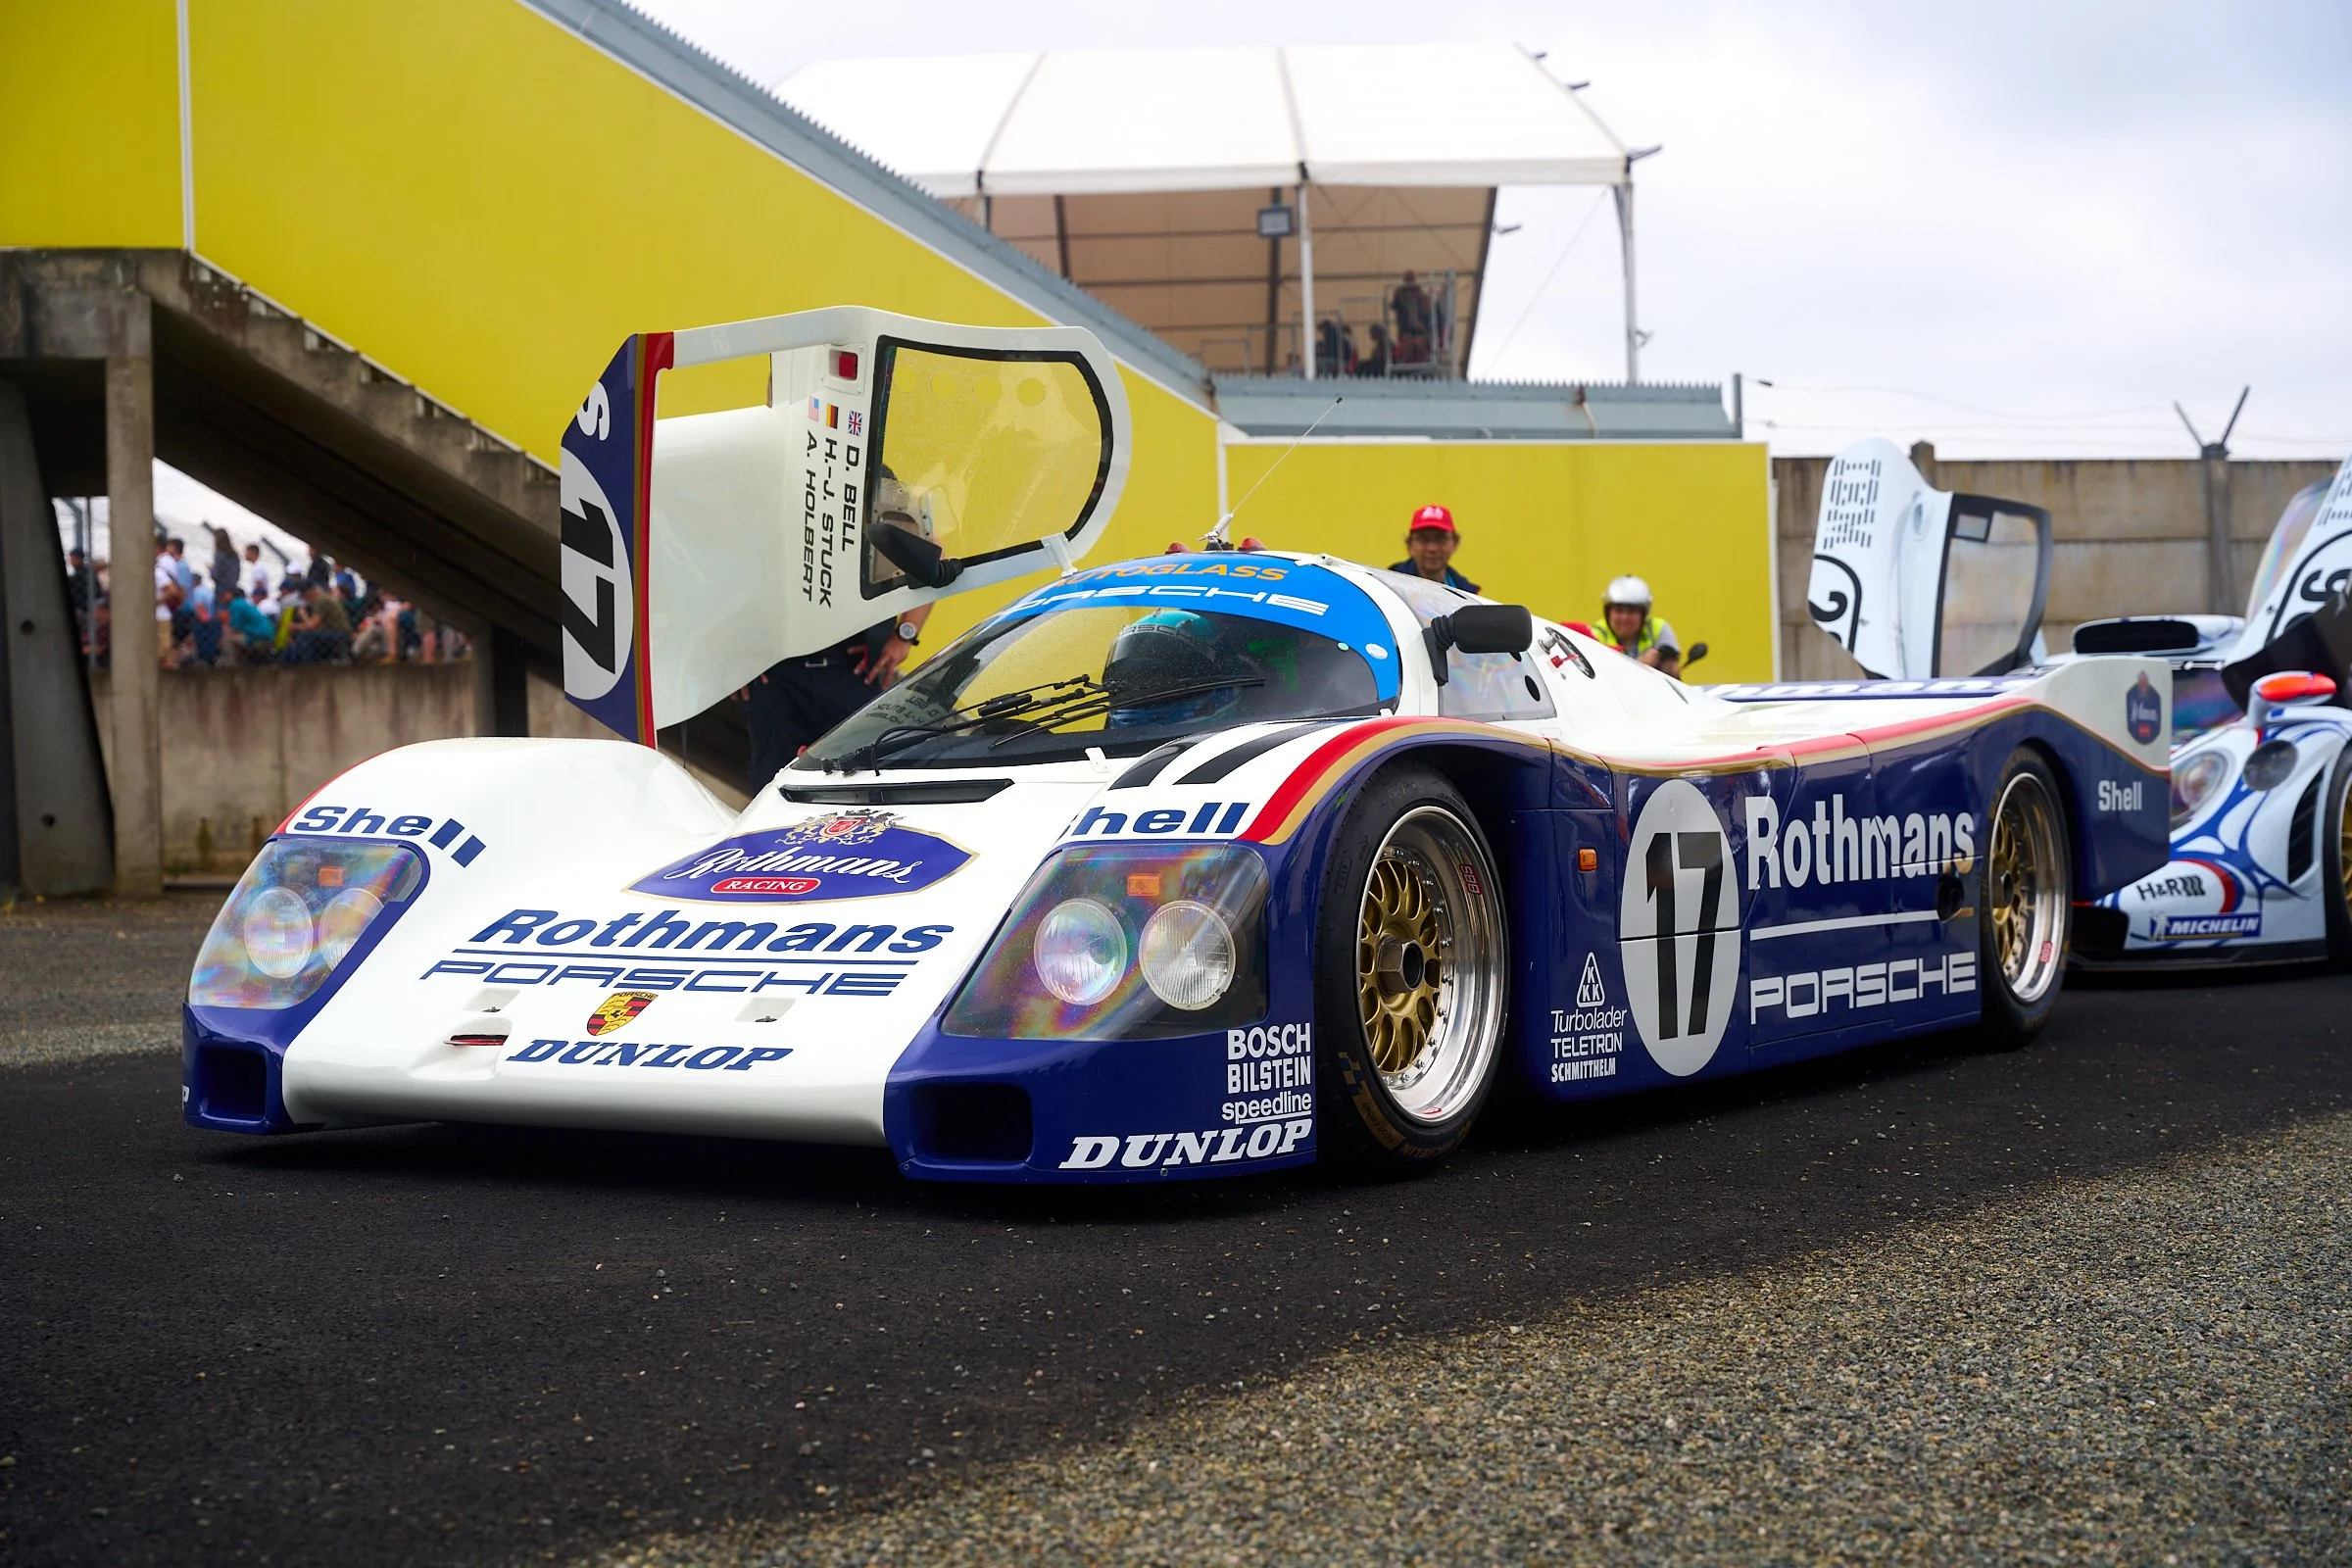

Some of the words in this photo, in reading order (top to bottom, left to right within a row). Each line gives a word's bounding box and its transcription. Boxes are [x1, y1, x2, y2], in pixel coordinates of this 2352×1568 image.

[807, 429, 818, 459] A.
[845, 445, 860, 472] D.
[822, 437, 838, 501] H.-J.
[841, 482, 858, 553] BELL
[1823, 458, 1882, 550] IBM
[802, 468, 816, 603] HOLBERT
[818, 512, 834, 609] STUCK
[560, 497, 616, 675] 17
[1002, 585, 1330, 617] ORSCHE
[2098, 780, 2142, 811] Shell
[293, 806, 487, 868] Shell
[1053, 803, 1250, 845] hell
[1745, 794, 1976, 891] Rothmans
[664, 846, 923, 884] Rothmans
[1460, 865, 1480, 894] BBS
[724, 879, 808, 891] RACING
[467, 908, 955, 955] Rothmans
[1645, 831, 1725, 1041] 17
[2169, 916, 2260, 935] MICHELIN
[419, 959, 908, 997] PORSCHE
[1750, 952, 1977, 1026] PORSCHE
[1550, 1004, 1628, 1033] Turbolader
[505, 1039, 794, 1071] DUNLOP
[1227, 1022, 1311, 1060] BOSCH
[1550, 1031, 1623, 1058] TELETRON
[1227, 1055, 1311, 1095] BILSTEIN
[1550, 1056, 1616, 1083] SCHMITTHELM
[1221, 1091, 1312, 1124] speedline
[1057, 1118, 1313, 1169] DUNLOP
